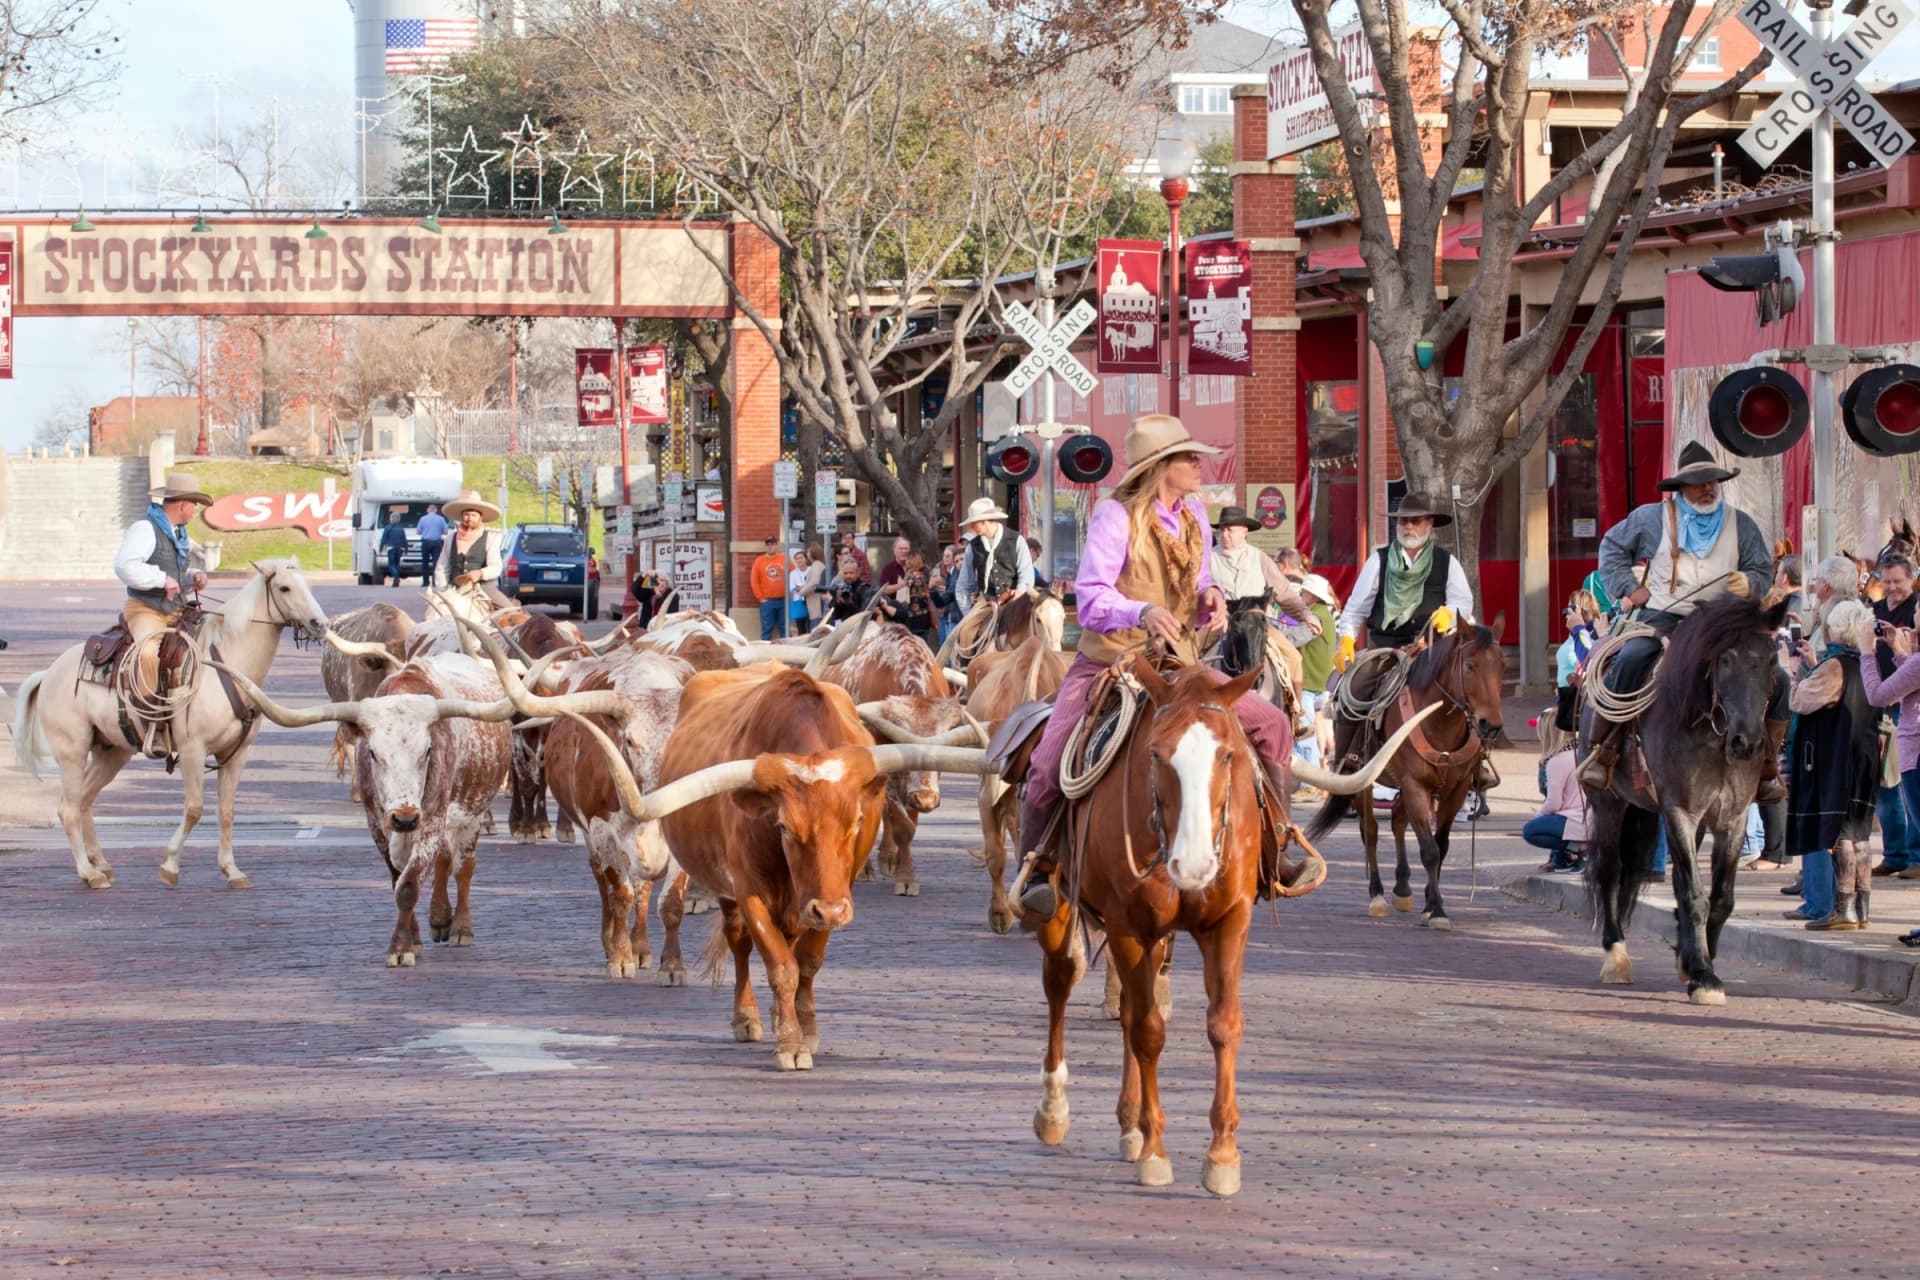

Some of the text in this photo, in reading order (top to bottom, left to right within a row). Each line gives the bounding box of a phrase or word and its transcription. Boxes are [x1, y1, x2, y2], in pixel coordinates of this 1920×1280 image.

[1745, 0, 1904, 157] RAIL ROAD
[1754, 4, 1898, 151] CROSSING
[44, 235, 594, 294] STOCKYARDS STATION
[1007, 305, 1094, 392] RAIL ROAD
[1011, 307, 1090, 390] CROSSING
[659, 545, 705, 556] COWBOY
[674, 570, 705, 581] URCH
